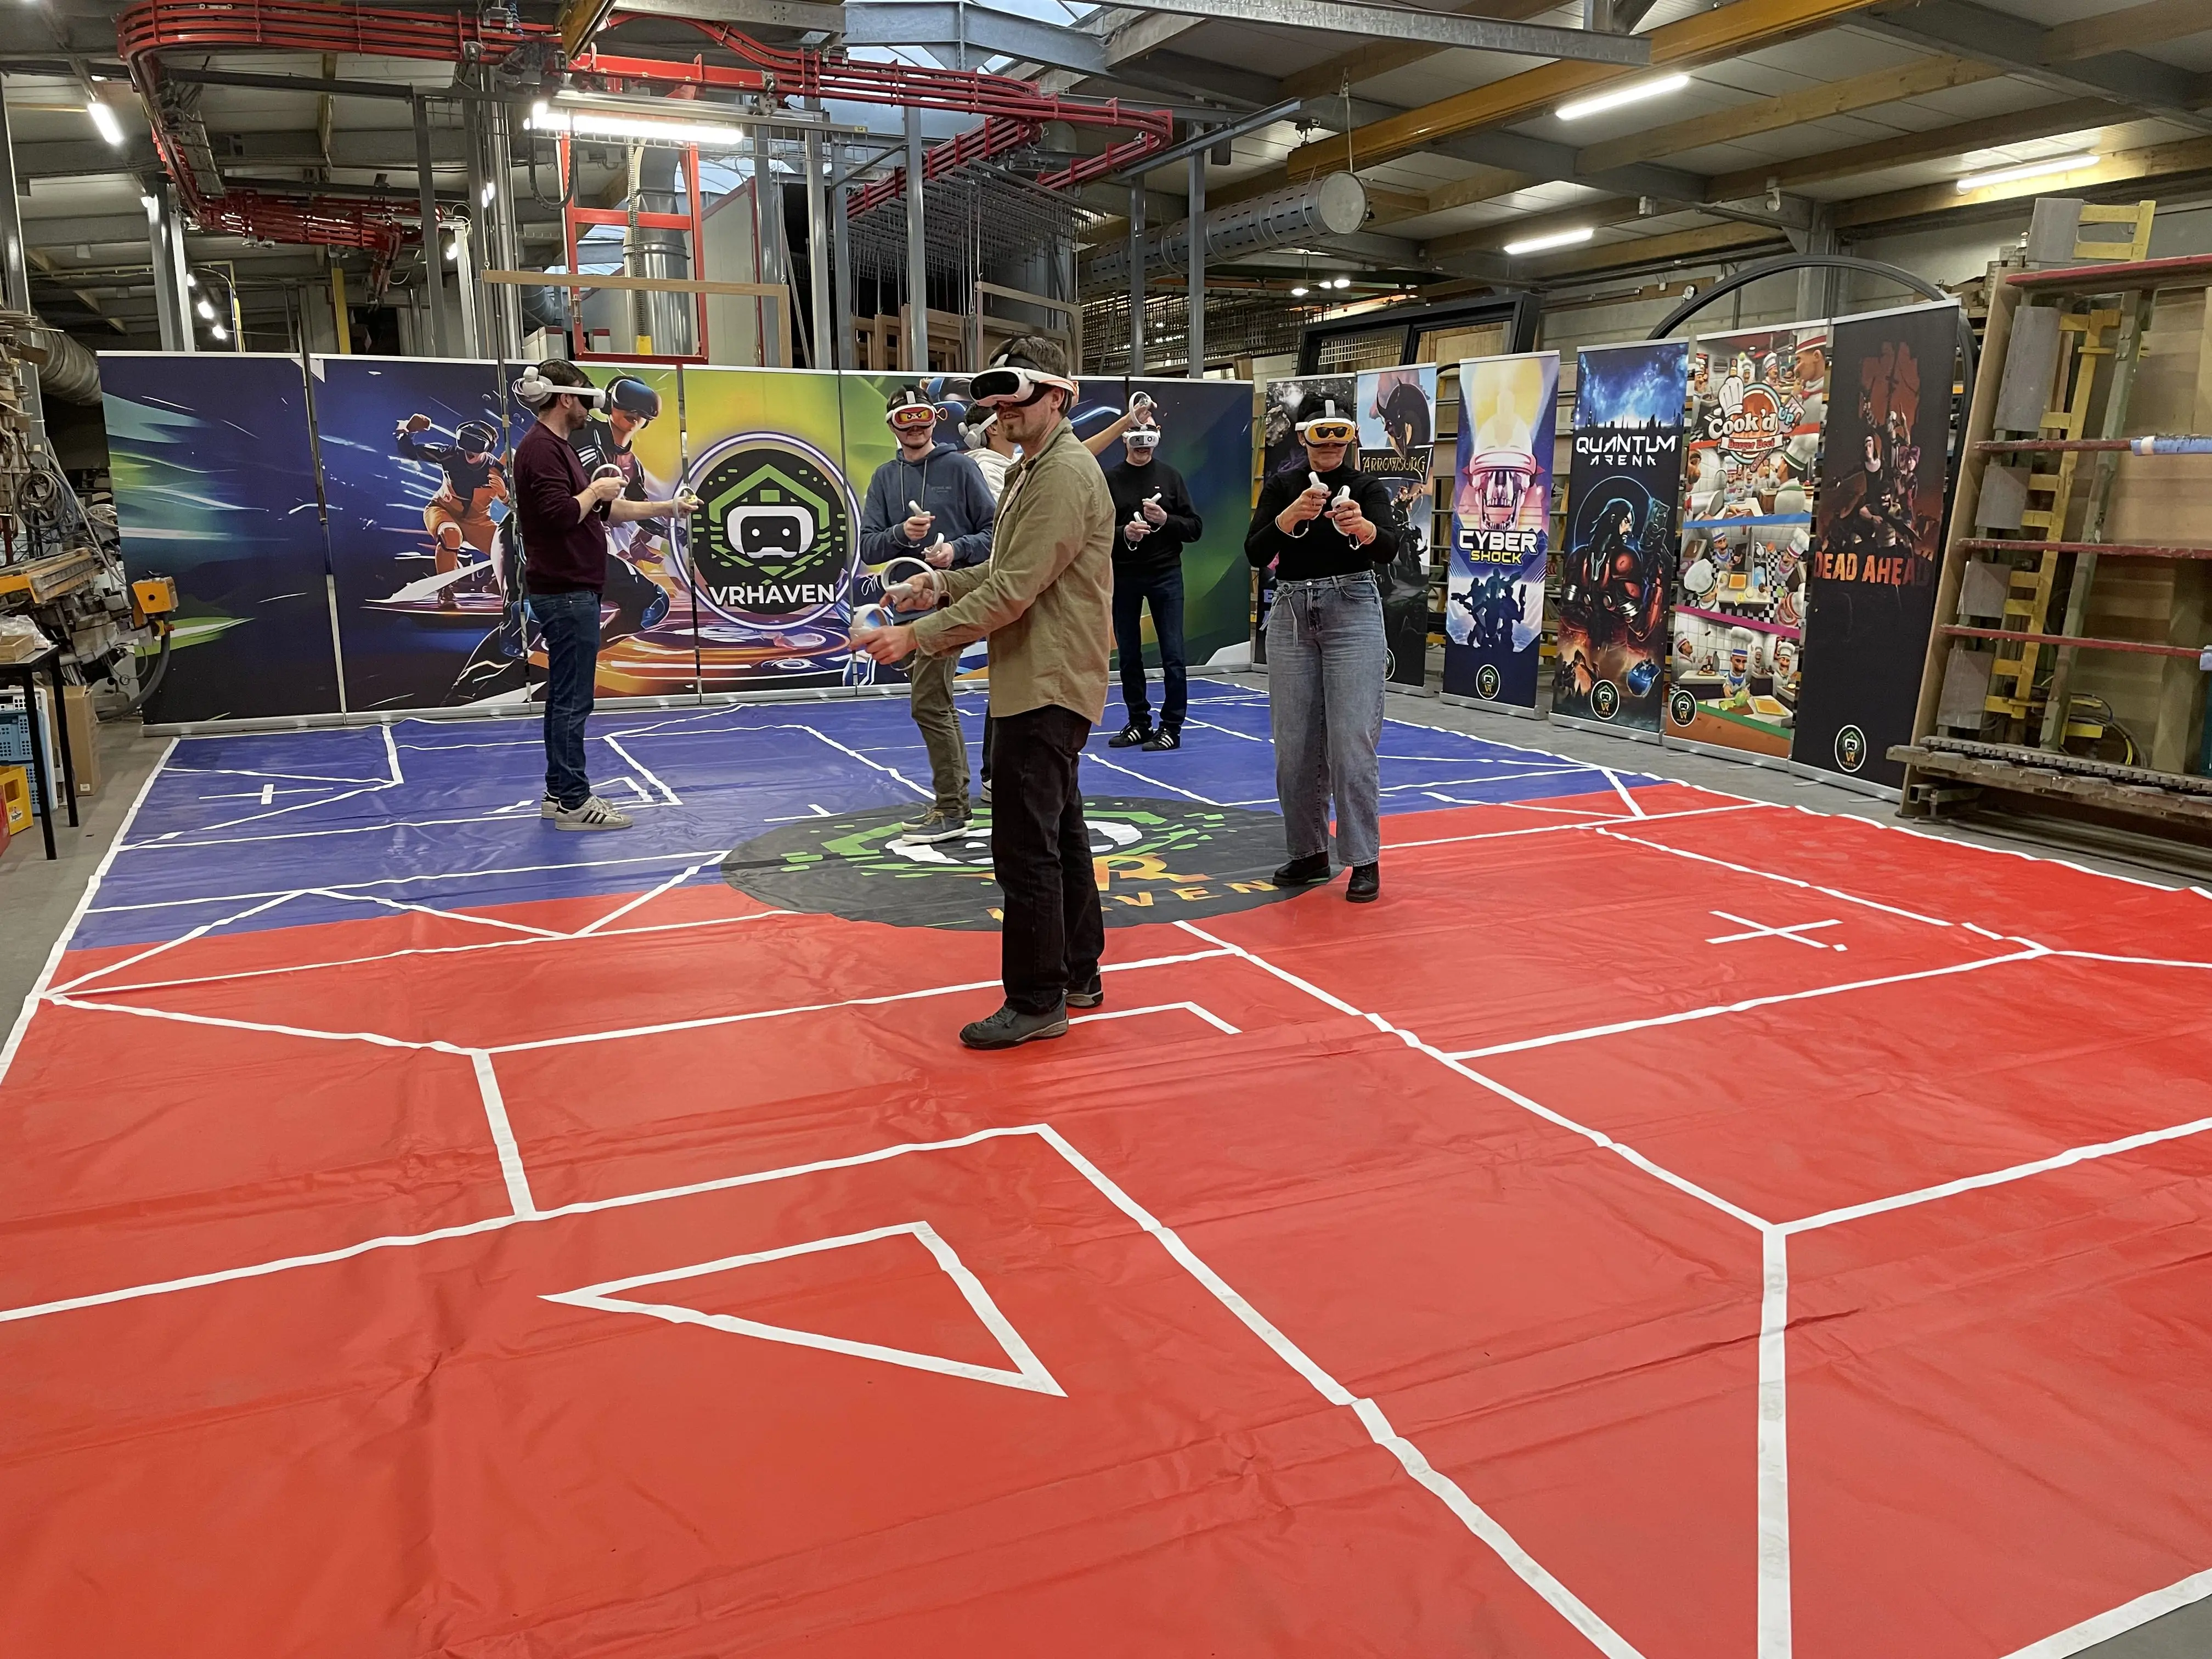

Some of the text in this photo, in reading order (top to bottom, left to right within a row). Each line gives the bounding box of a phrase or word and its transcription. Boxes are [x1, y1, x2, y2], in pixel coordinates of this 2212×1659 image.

[1708, 409, 1776, 439] Cook'd
[1576, 433, 1677, 455] QUANTUM
[1590, 455, 1656, 467] ARENA
[1459, 530, 1537, 553] CYBER
[1470, 550, 1522, 564] SHOCK
[1814, 551, 1931, 586] DEAD AHEAD
[709, 584, 834, 605] VRHAVEN
